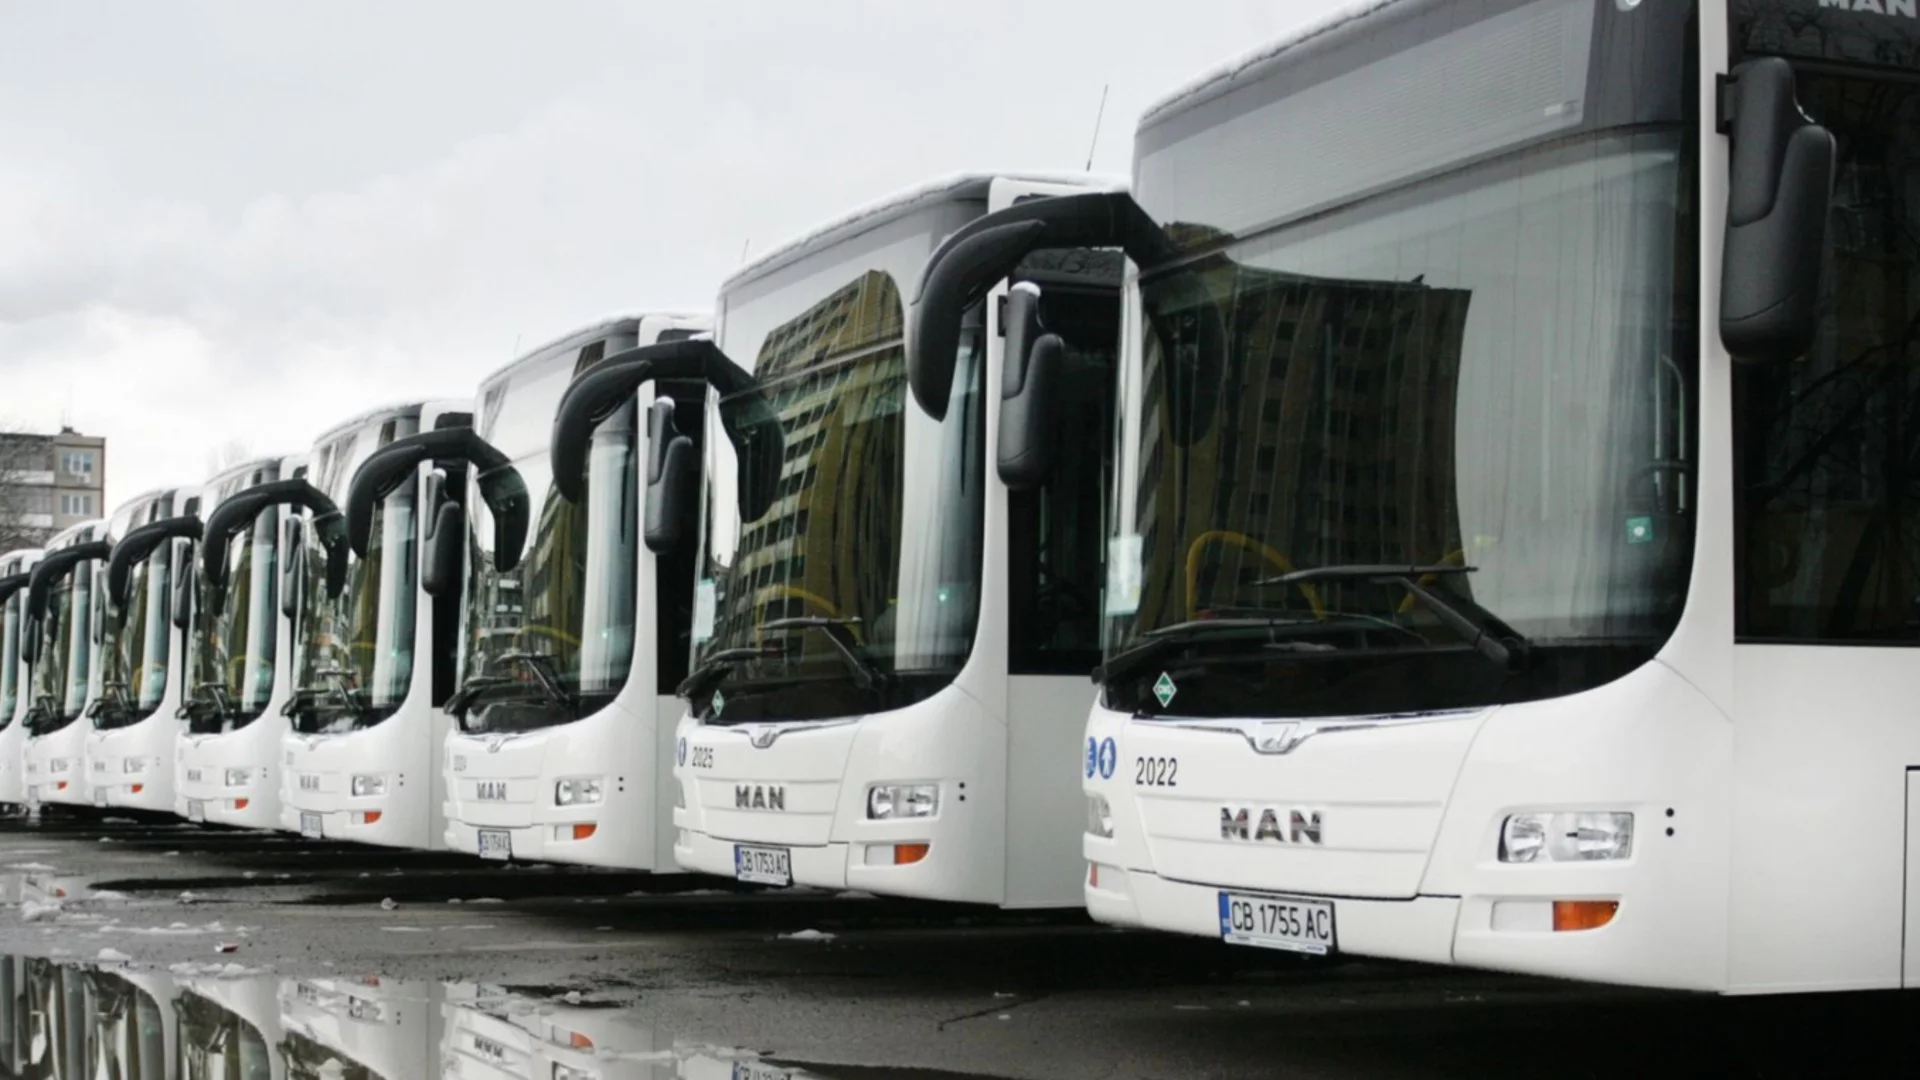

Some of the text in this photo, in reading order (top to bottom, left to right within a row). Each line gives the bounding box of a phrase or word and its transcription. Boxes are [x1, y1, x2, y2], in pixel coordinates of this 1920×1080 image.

[692, 746, 714, 769] 2025
[1135, 756, 1178, 786] 2022
[735, 785, 785, 810] MAN
[1220, 807, 1321, 843] MAN
[741, 850, 788, 876] CB 1753 AC
[1231, 901, 1329, 940] CB 1755 AC
